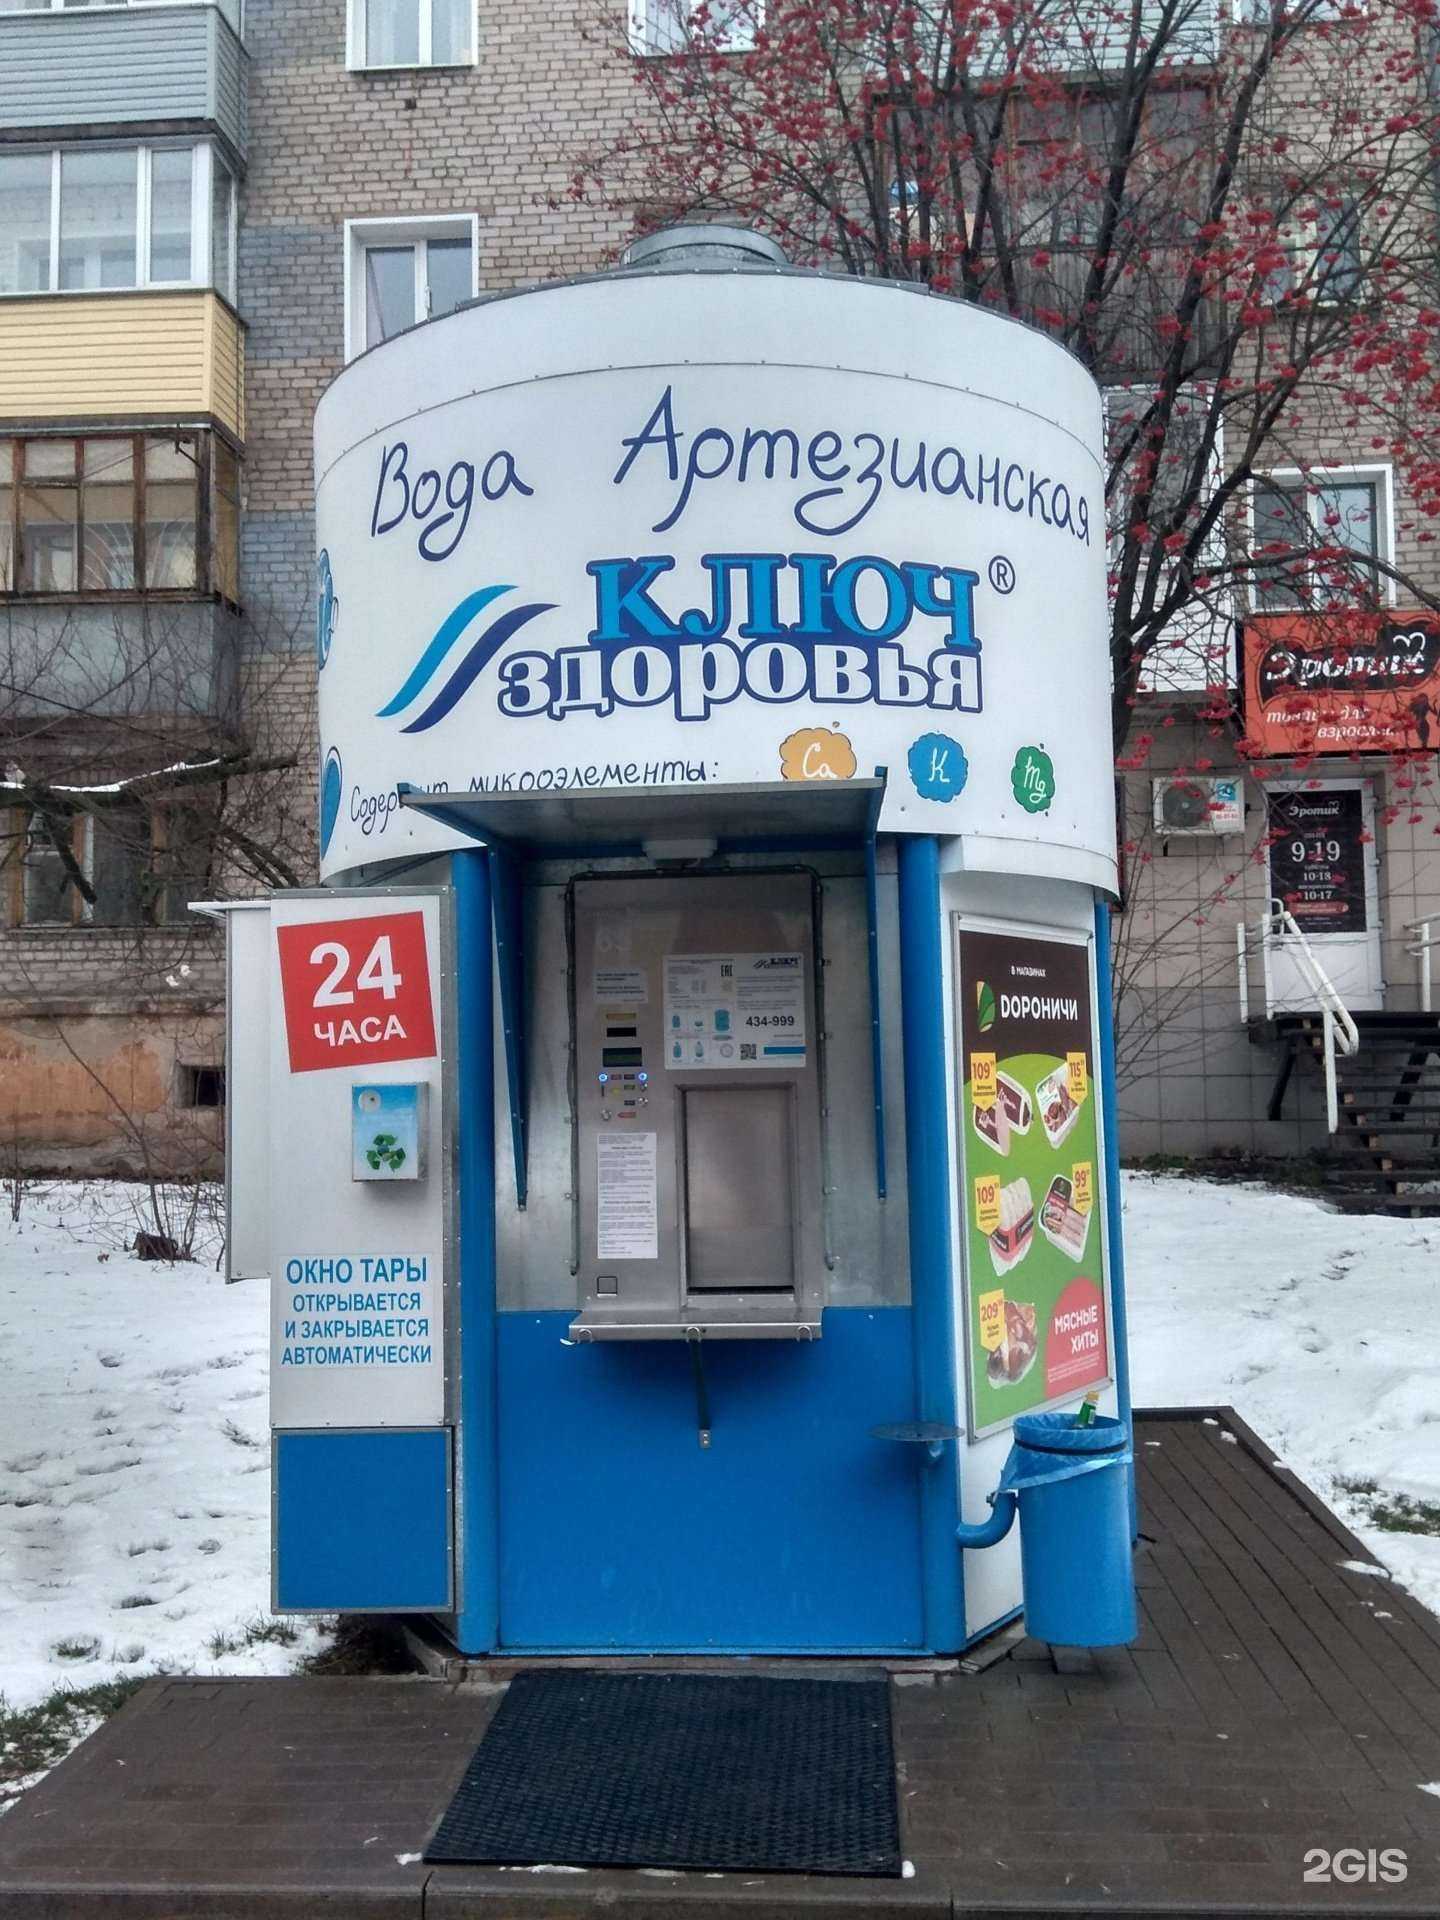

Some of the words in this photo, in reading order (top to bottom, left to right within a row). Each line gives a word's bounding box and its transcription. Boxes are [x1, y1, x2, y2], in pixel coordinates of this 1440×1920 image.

[370, 441, 534, 561] Вода
[614, 385, 1092, 546] Артезианская
[497, 636, 983, 722] здоровья
[1023, 756, 1047, 803] Mg
[310, 935, 402, 1008] 24
[314, 1014, 407, 1047] ЧАСА
[746, 1015, 795, 1027] 434-999
[286, 1258, 353, 1284] ОКНО
[360, 1257, 427, 1282] ТАРЫ
[293, 1292, 421, 1312] ОТКРЫВАЕТСЯ
[285, 1321, 296, 1338] И
[301, 1318, 429, 1338] ЗАКРЫВАЕТСЯ
[1055, 1305, 1098, 1335] МЯСНЫЕ
[282, 1345, 432, 1365] АВТОМАТИЧЕСКИ
[1071, 1329, 1099, 1354] ХИТЫ
